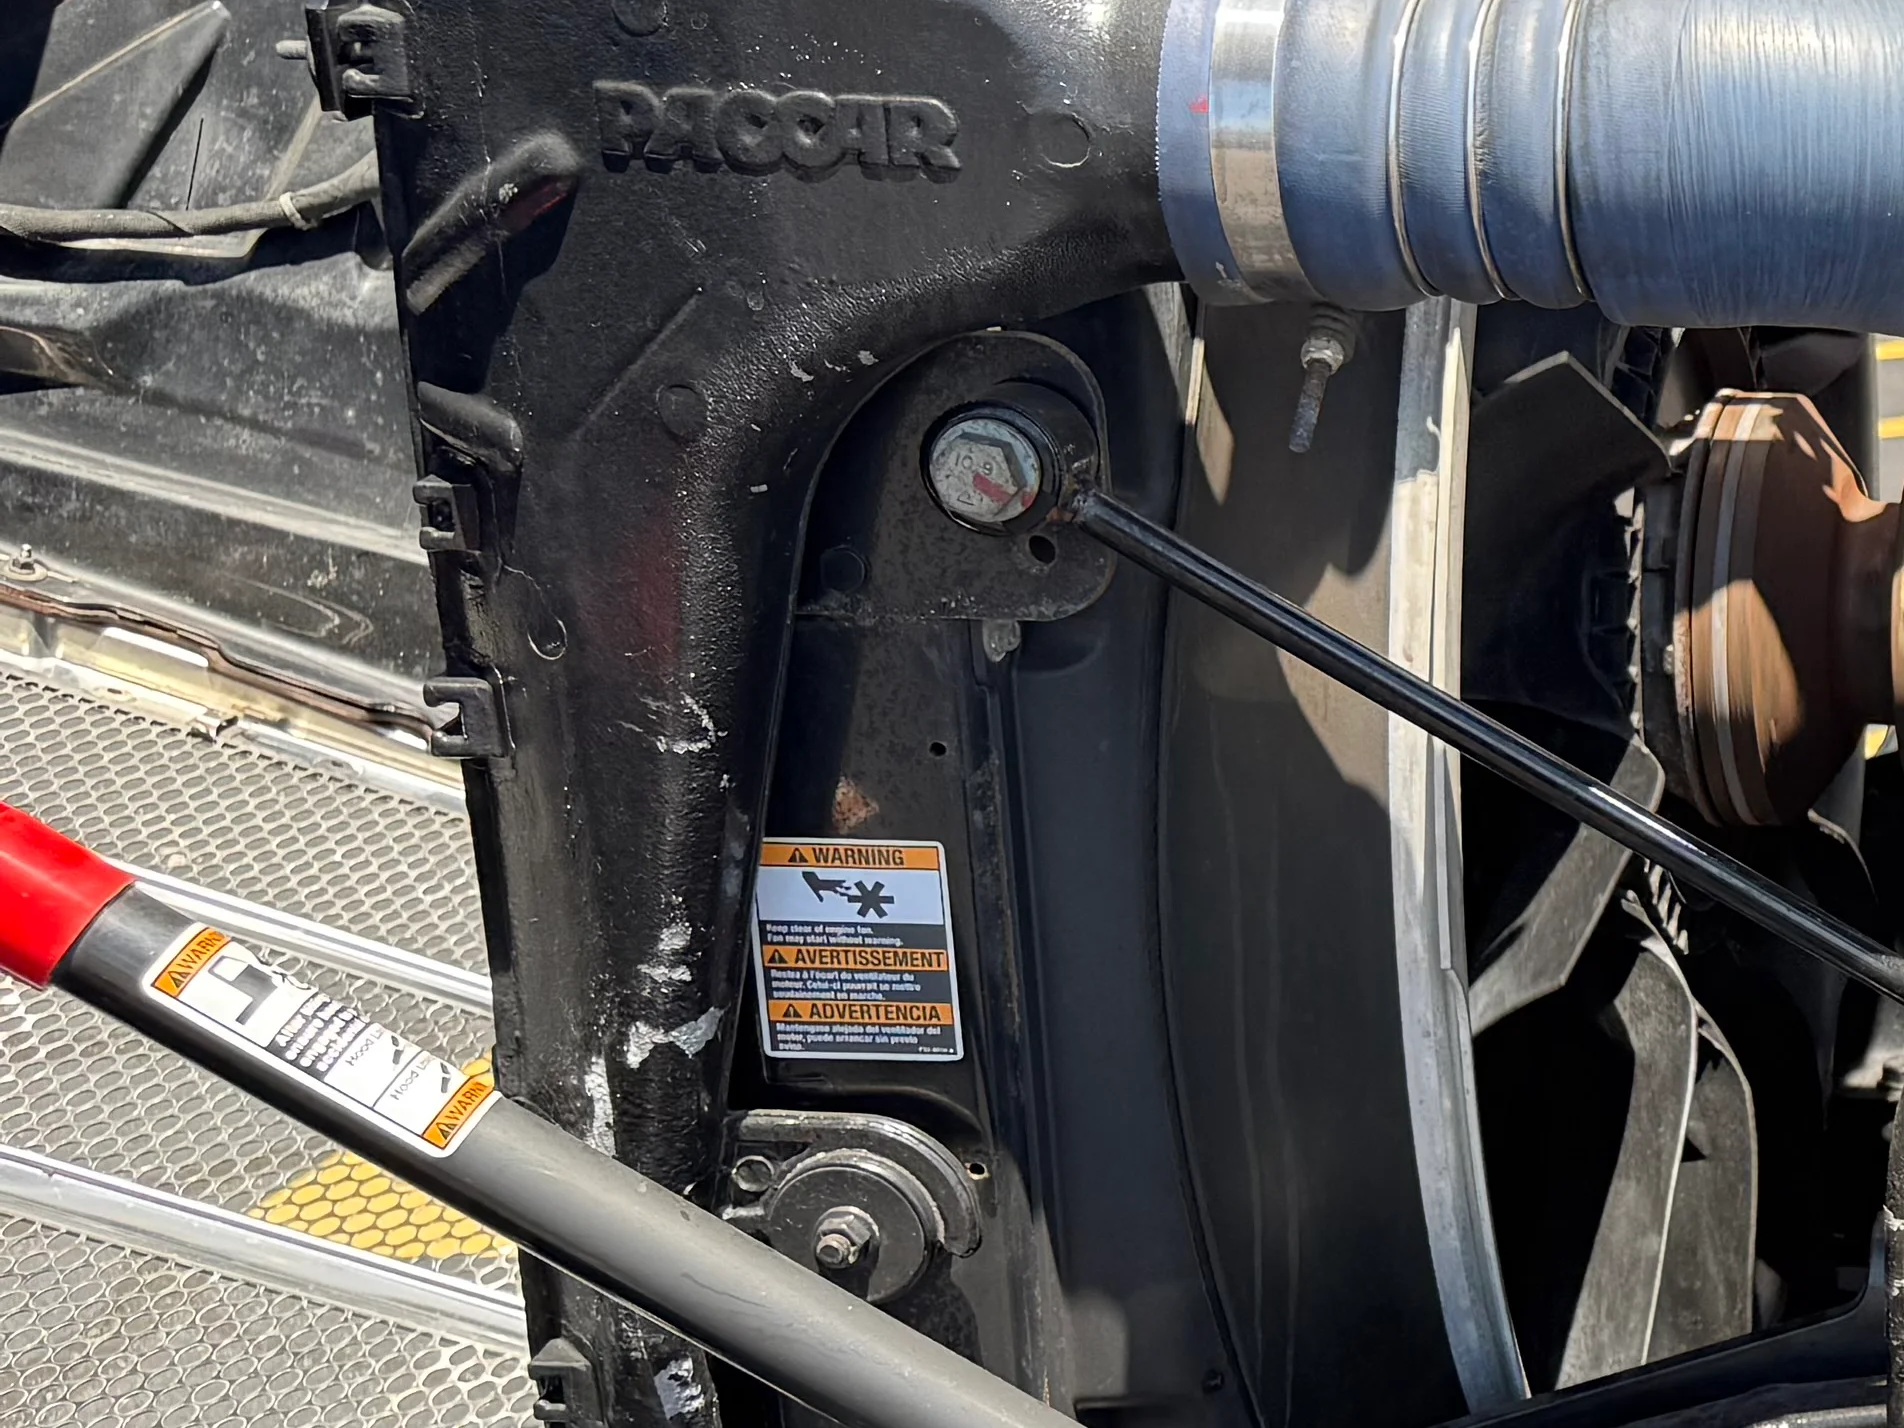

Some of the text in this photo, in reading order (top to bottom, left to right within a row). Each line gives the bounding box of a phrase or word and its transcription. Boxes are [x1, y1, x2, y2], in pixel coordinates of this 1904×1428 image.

[593, 80, 961, 180] PACCAR
[812, 847, 904, 866] WARNING
[795, 950, 944, 968] AVERTISSEMENT
[809, 1004, 941, 1022] ADVERTENCIA
